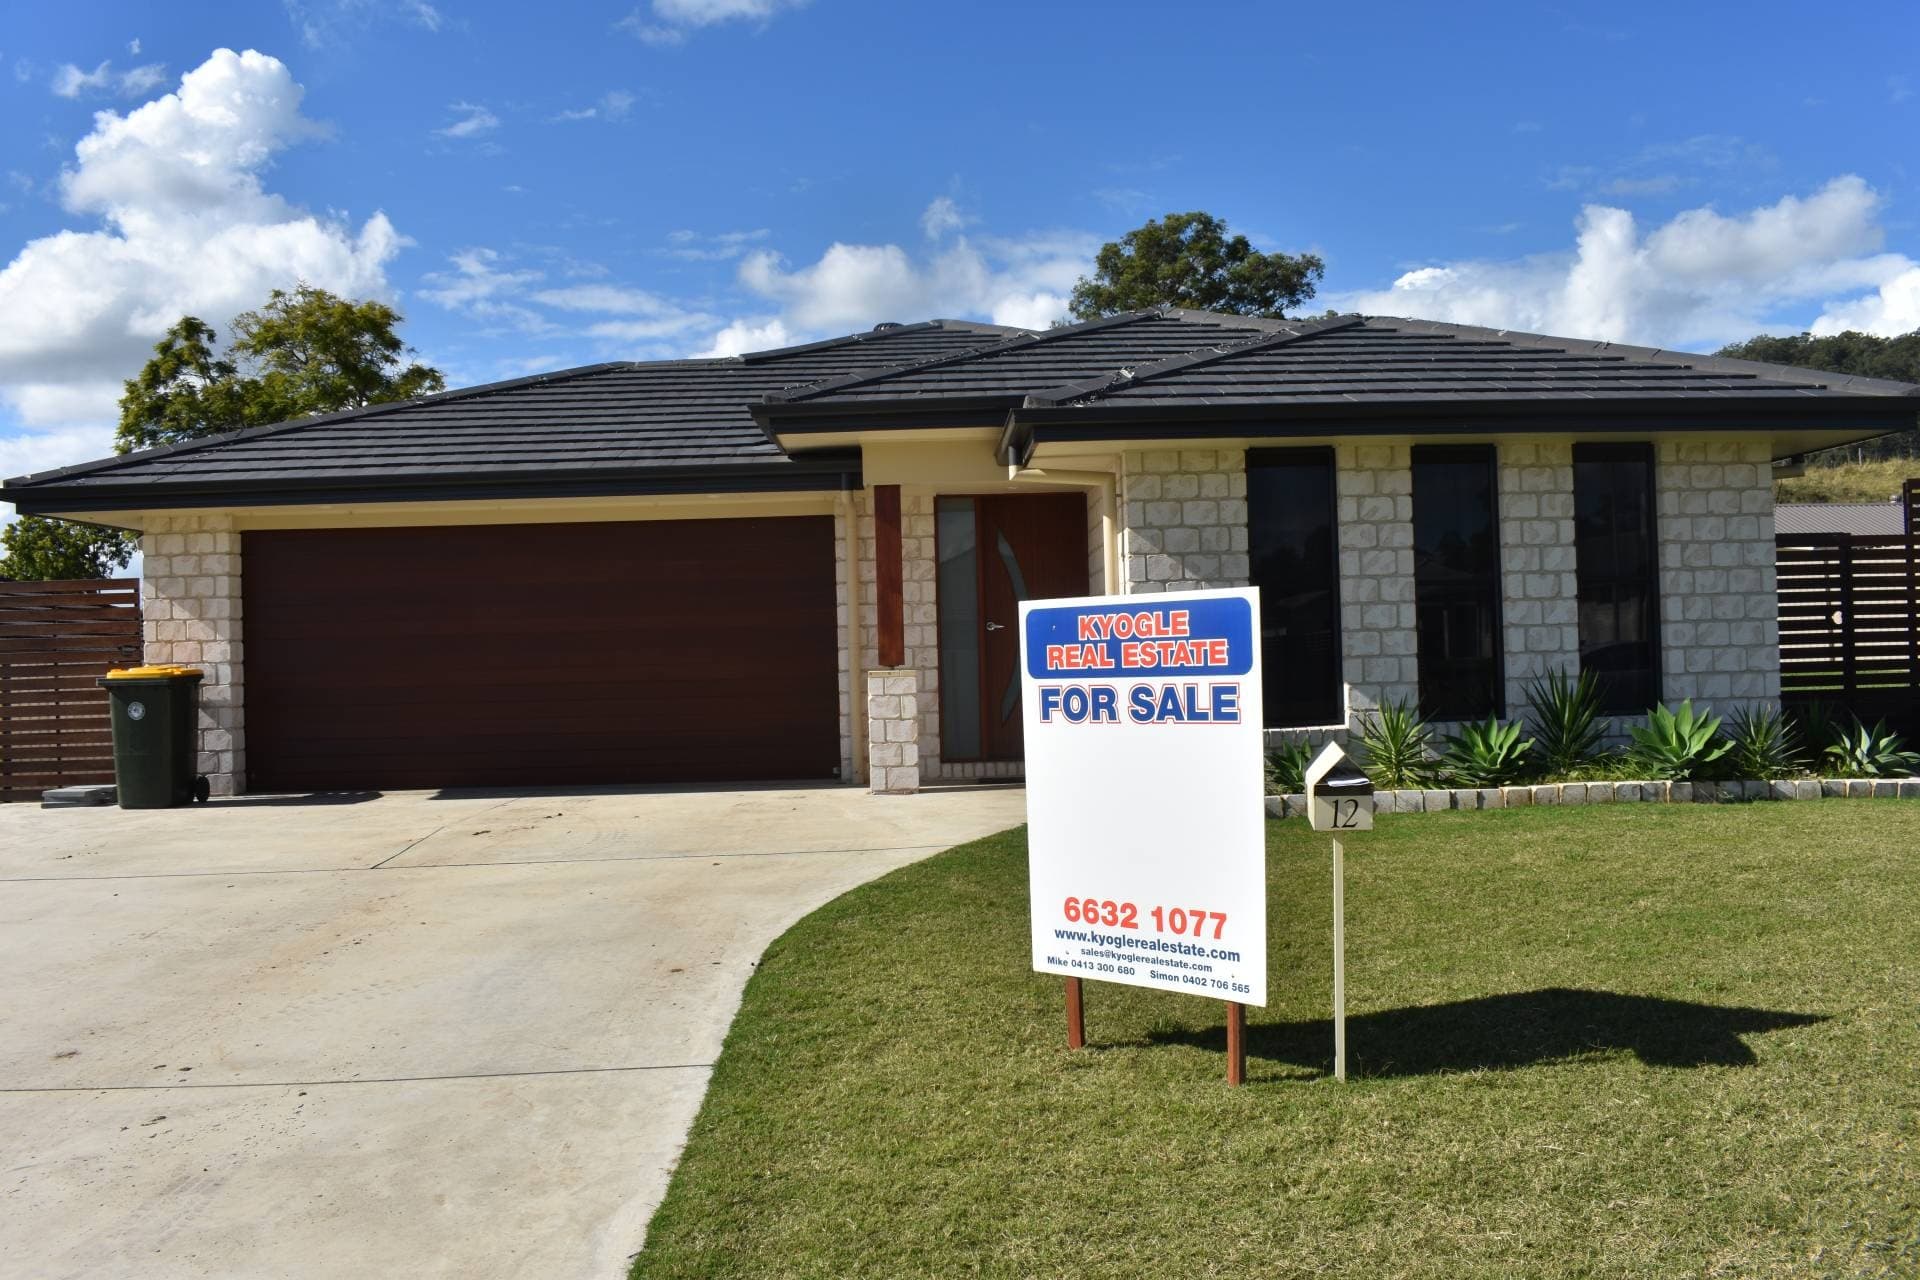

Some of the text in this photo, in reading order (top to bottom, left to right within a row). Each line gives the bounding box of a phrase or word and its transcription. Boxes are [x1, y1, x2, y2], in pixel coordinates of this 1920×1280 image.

[1078, 610, 1190, 640] KYOGLE
[1046, 639, 1228, 670] REAL ESTATE
[1039, 682, 1242, 725] FOR SALE
[1331, 799, 1359, 829] 12
[1063, 896, 1227, 940] 6632 1077
[1054, 928, 1241, 963] www.kyoglerealestate.com
[1080, 947, 1213, 973] sales@kyoglerealestate.com
[1047, 956, 1250, 994] Mike 0413 300 680 Simon 0402 706 565
